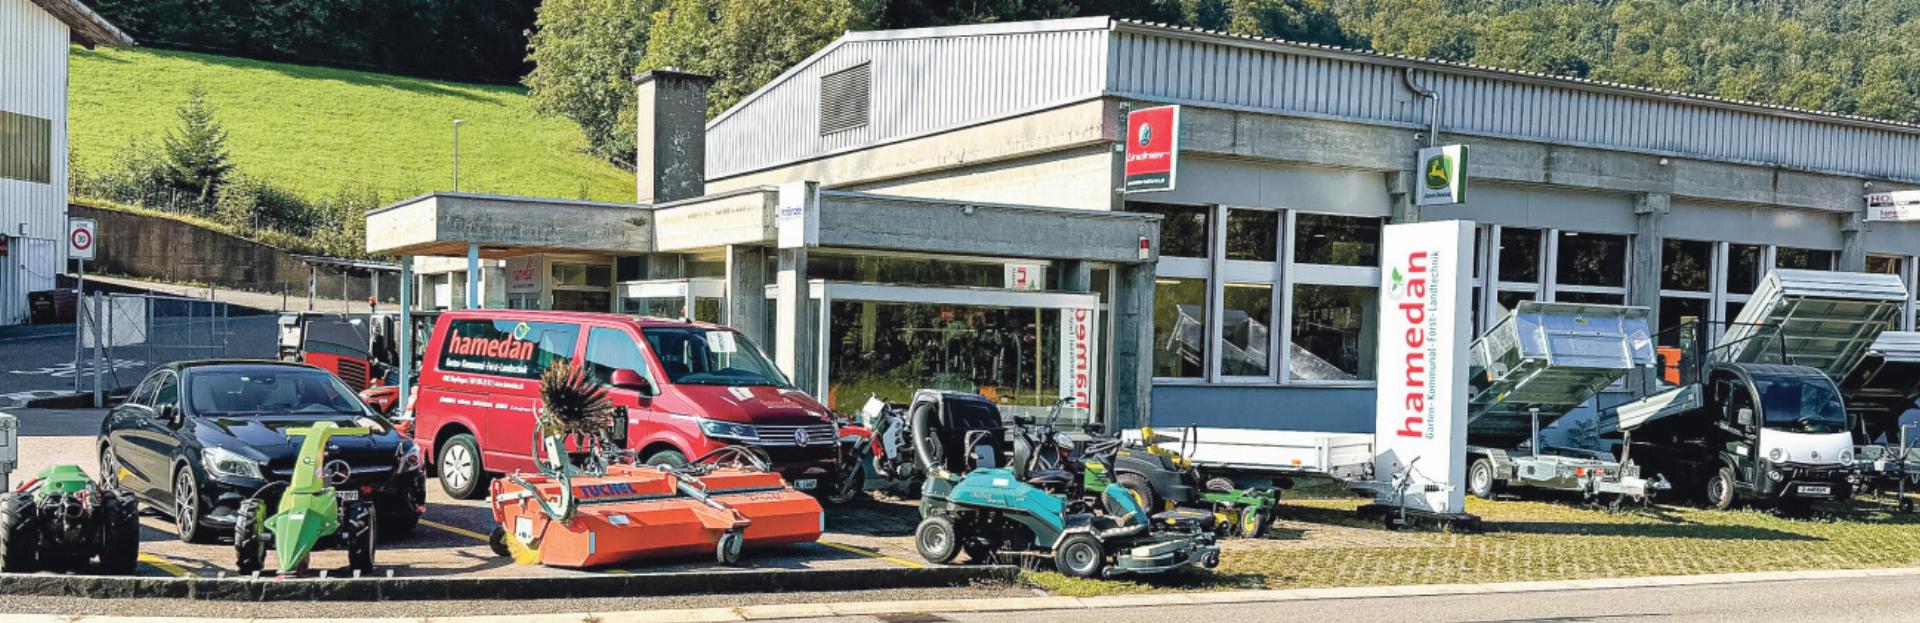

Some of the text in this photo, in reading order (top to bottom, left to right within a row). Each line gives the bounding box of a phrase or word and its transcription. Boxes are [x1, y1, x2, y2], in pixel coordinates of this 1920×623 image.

[77, 234, 87, 244] 30
[448, 329, 534, 360] hamedan
[1396, 251, 1428, 439] hamedan
